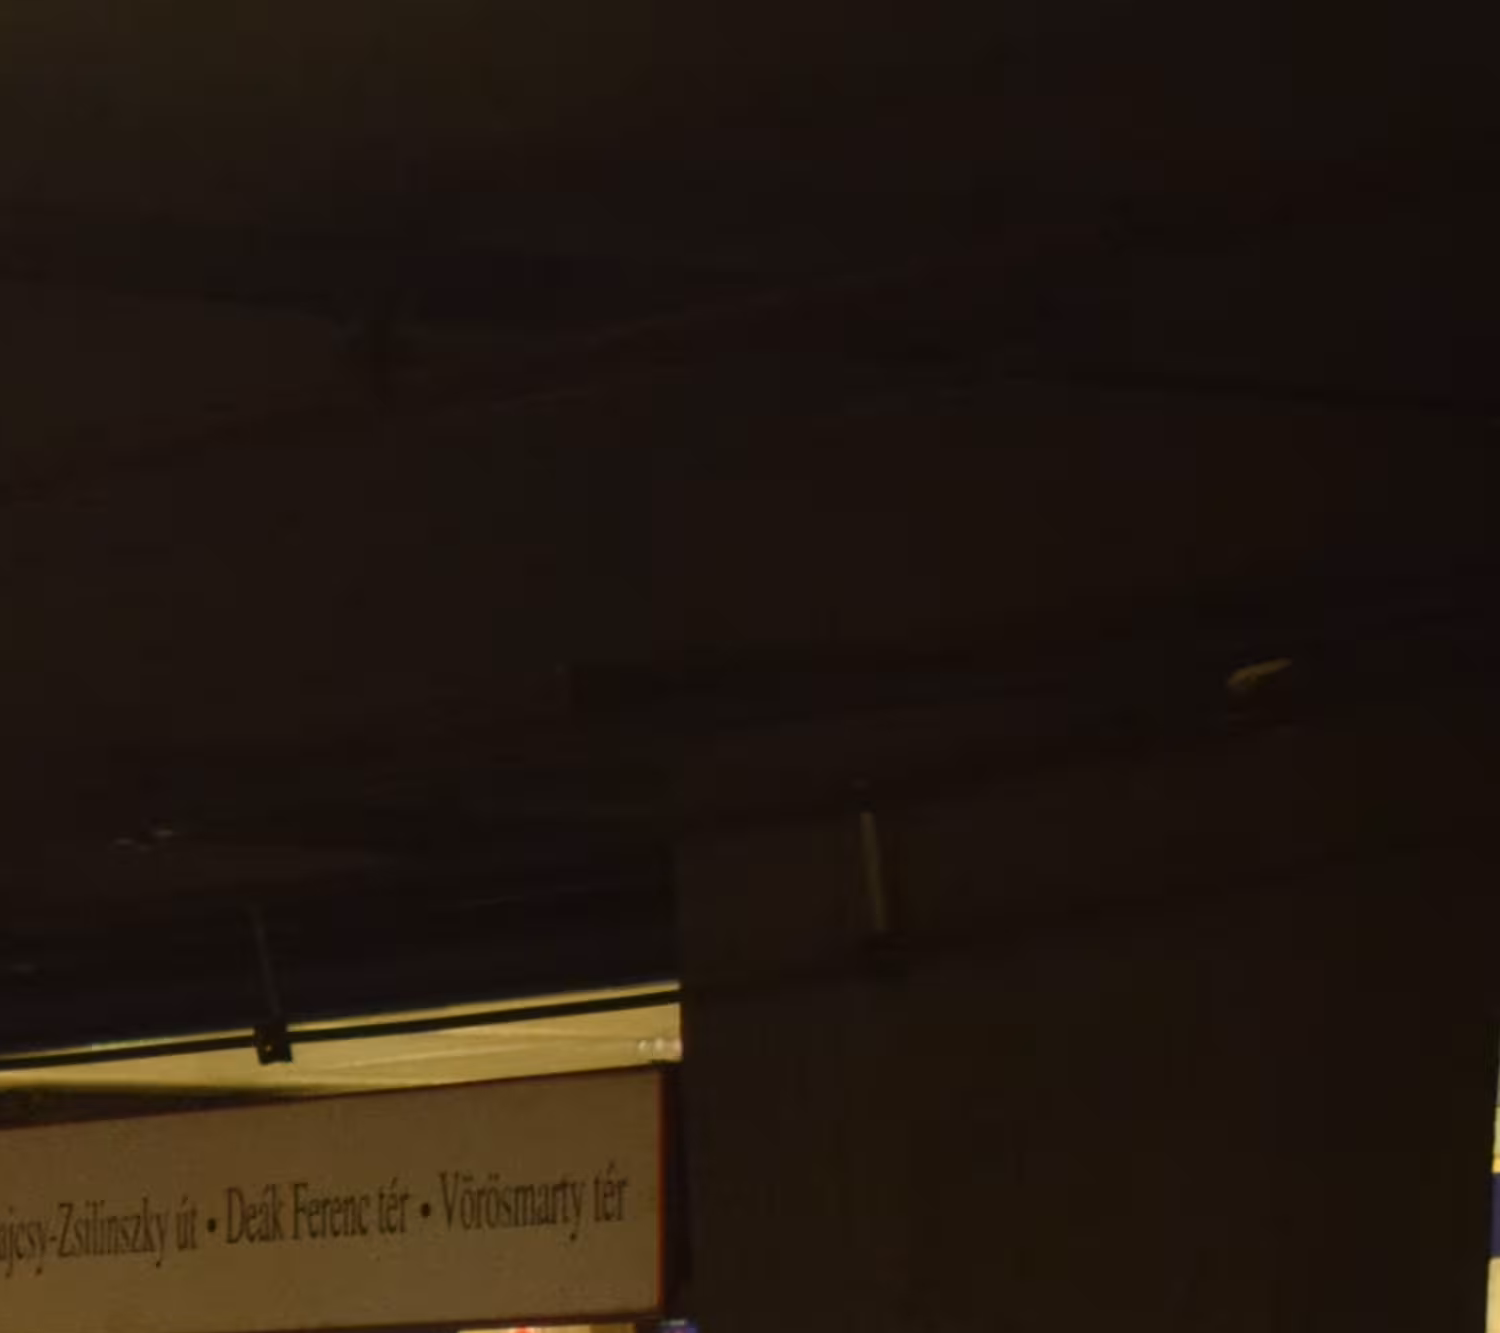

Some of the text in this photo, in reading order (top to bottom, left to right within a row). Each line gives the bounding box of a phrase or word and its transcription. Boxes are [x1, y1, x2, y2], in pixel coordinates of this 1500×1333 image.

[175, 1194, 199, 1252] út
[225, 1184, 285, 1244] Deák
[292, 1181, 371, 1240] Ferenc
[377, 1176, 412, 1235] tér
[438, 1168, 588, 1243] Vörösmarty
[593, 1160, 628, 1223] tér
